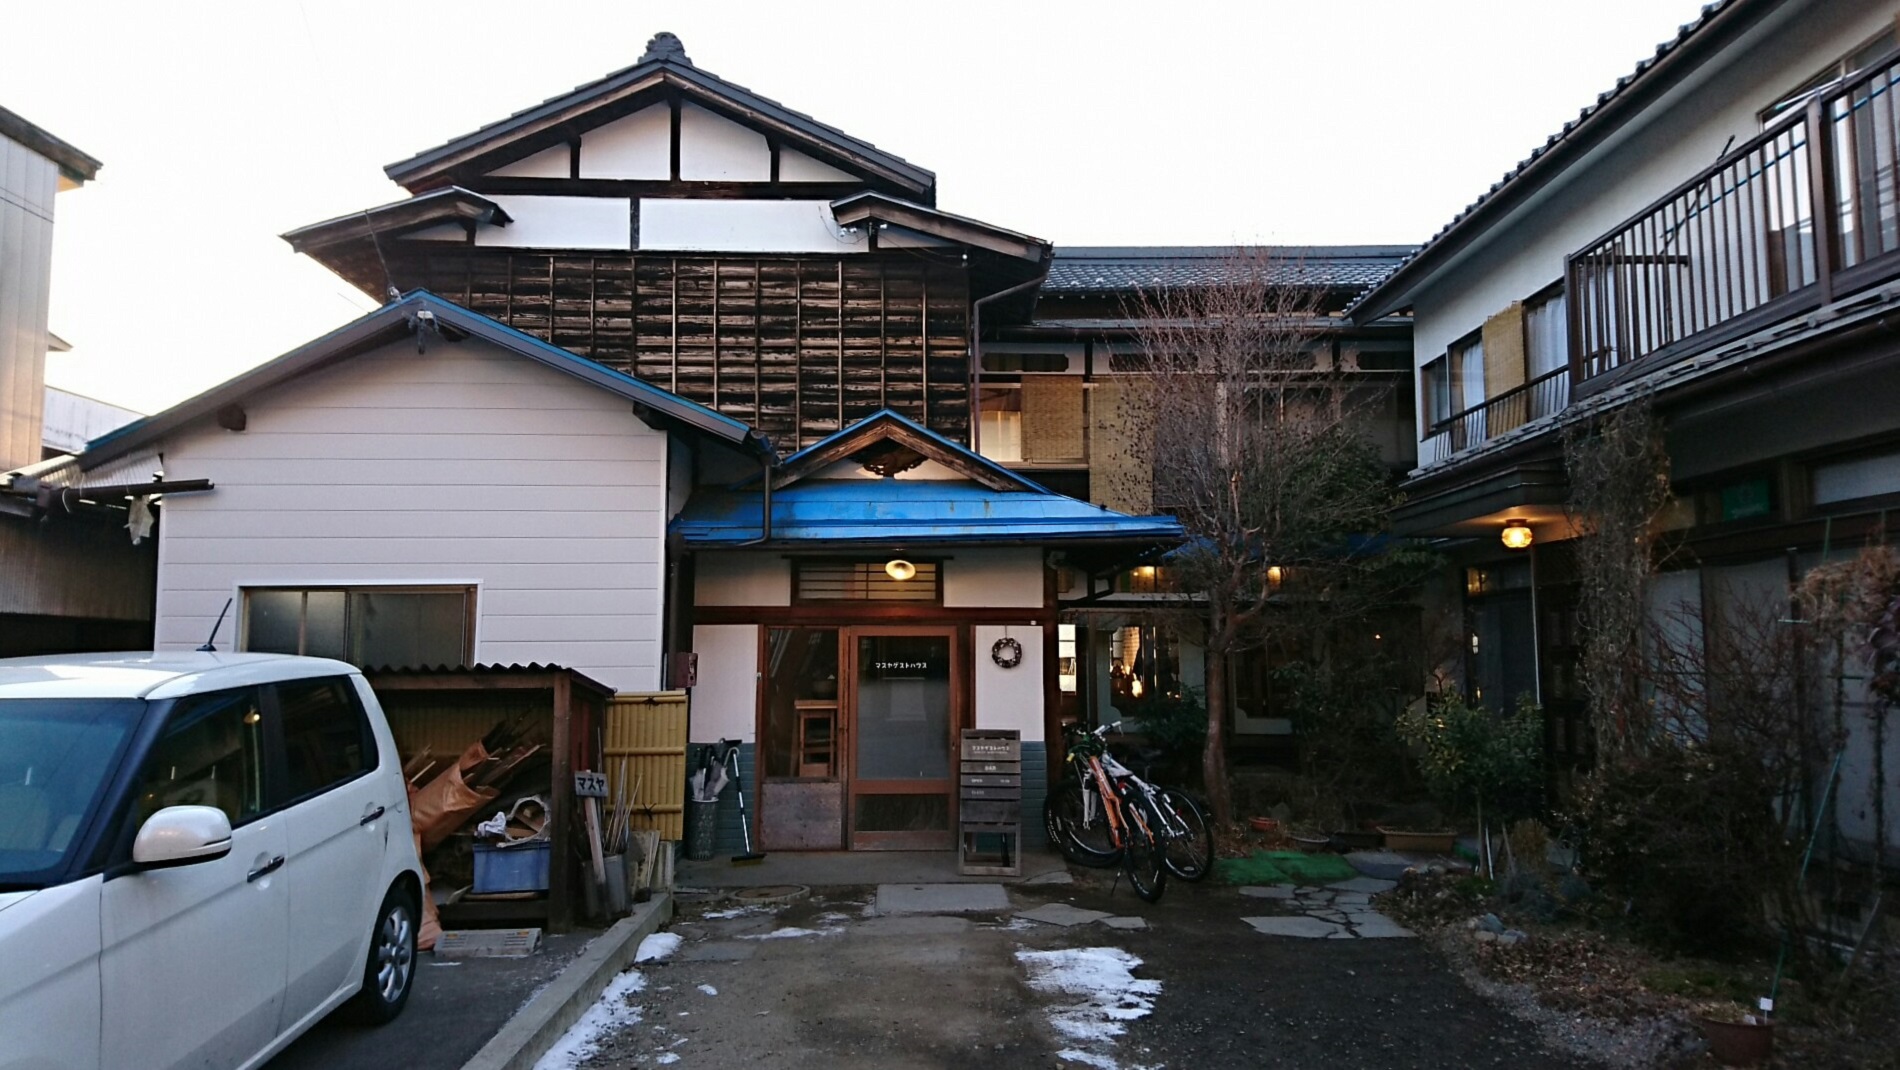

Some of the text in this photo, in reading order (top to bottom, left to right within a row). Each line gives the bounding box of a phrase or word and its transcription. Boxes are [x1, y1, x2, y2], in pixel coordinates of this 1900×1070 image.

[875, 661, 928, 669] マスヤゲストハウス
[577, 776, 605, 792] マスヤ
